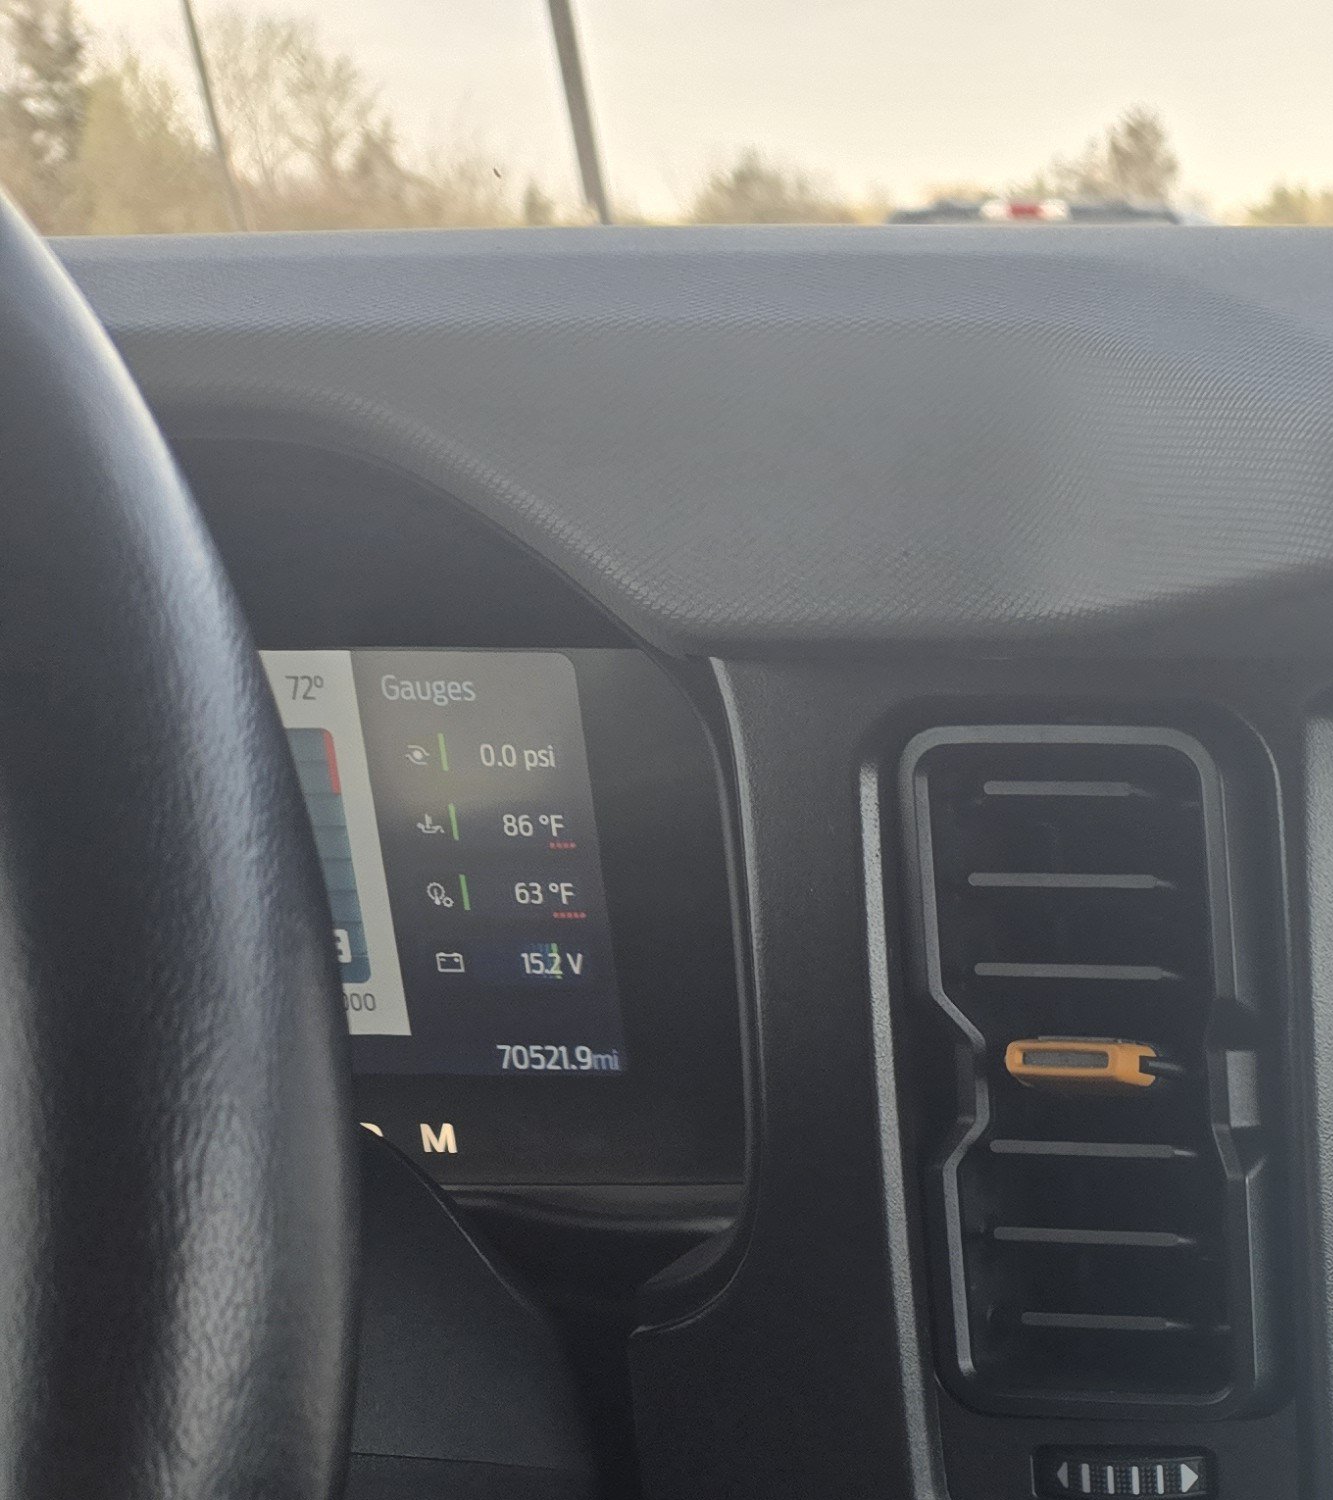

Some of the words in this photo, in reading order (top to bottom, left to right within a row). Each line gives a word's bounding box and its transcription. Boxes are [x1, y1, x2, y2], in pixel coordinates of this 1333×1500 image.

[381, 675, 476, 706] Gauges
[479, 745, 516, 768] 0.0
[524, 745, 556, 773] psi
[502, 814, 533, 837] 86
[515, 882, 543, 905] 63
[520, 952, 562, 976] 15.2
[566, 953, 583, 975] V
[420, 1123, 458, 1153] M
